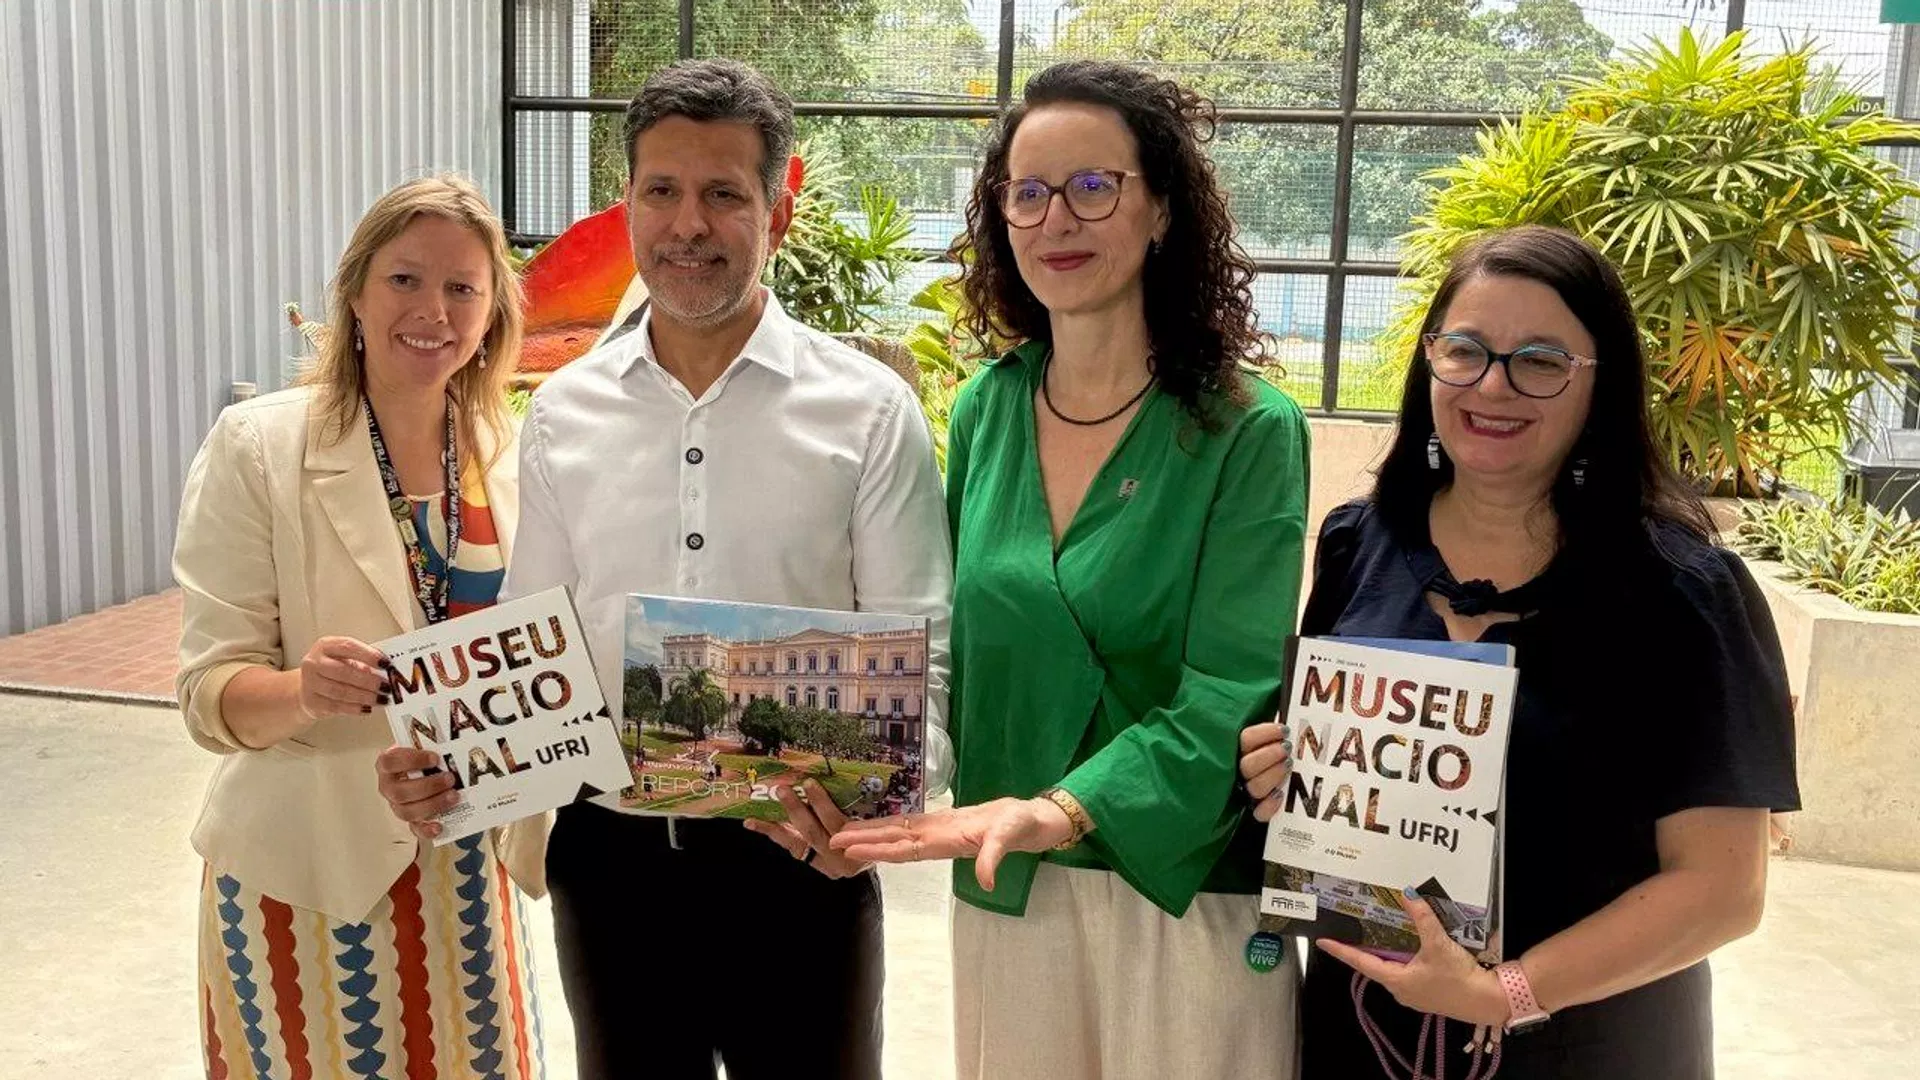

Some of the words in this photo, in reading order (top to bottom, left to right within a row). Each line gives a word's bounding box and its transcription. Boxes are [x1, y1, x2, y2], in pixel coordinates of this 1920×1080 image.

[386, 615, 567, 704] MUSEU
[402, 670, 572, 751] NACIO
[1300, 665, 1494, 737] MUSEU
[535, 735, 590, 765] UFRJ
[641, 774, 750, 799] REPORT
[1296, 718, 1472, 791] NACIO
[1284, 771, 1390, 835] NAL
[1400, 818, 1459, 853] UFRJ
